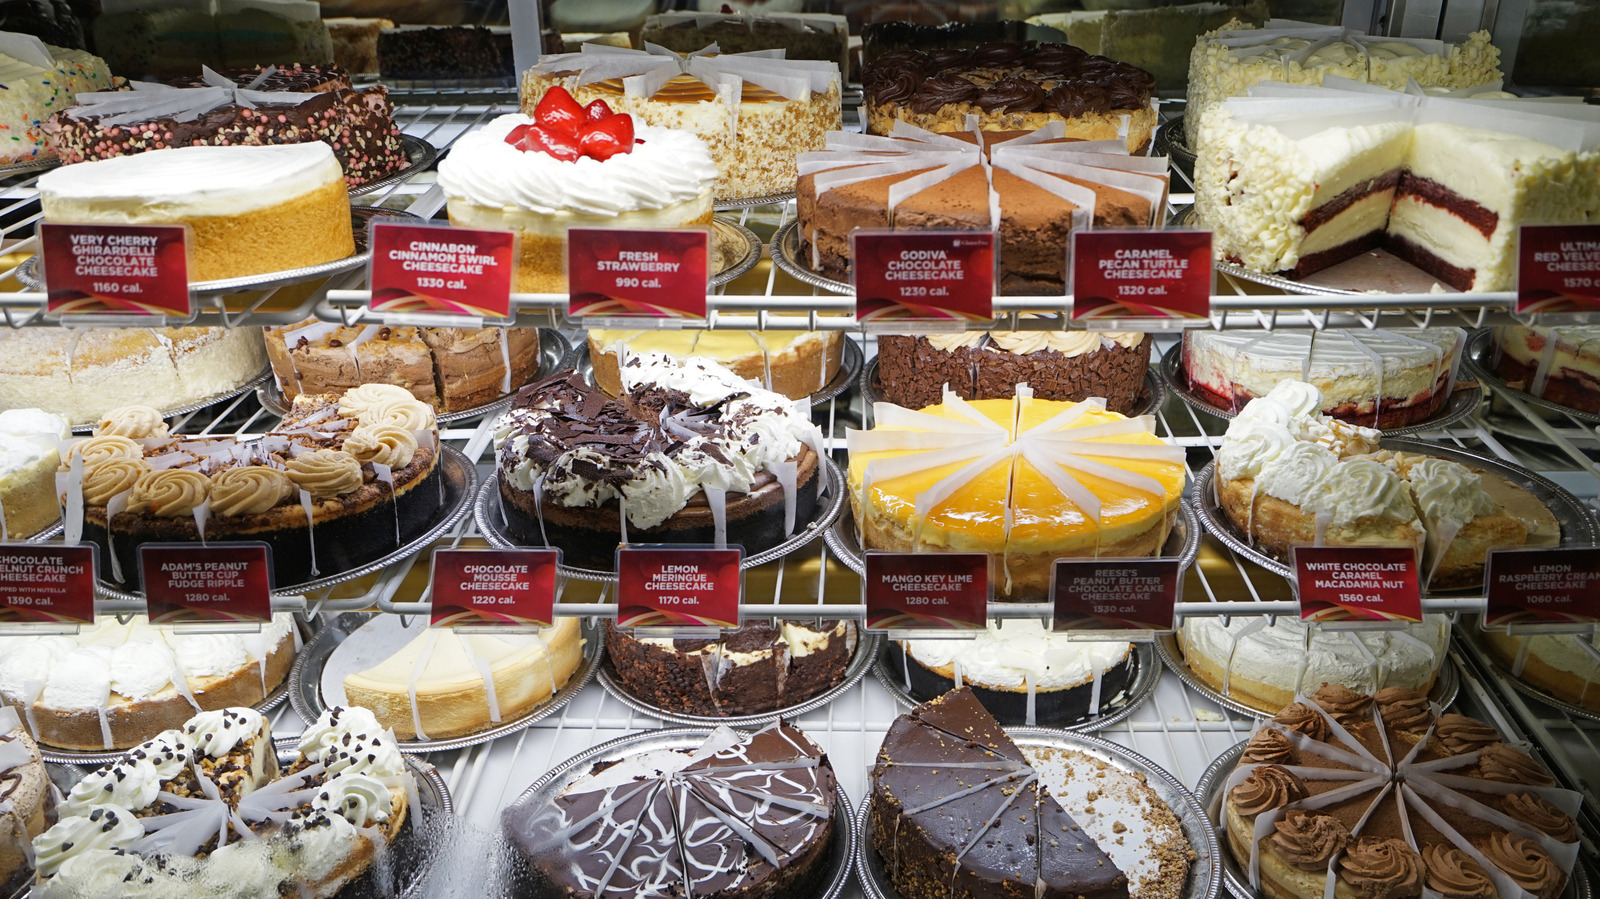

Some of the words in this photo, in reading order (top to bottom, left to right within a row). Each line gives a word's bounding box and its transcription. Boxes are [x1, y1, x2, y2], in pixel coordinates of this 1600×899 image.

[70, 235, 104, 244] VERY
[107, 236, 158, 246] CHERRY
[72, 246, 156, 256] GHIRARDELLI
[410, 241, 475, 254] CINNABON
[389, 250, 456, 262] CINNAMON
[458, 255, 498, 265] SWIRL
[619, 252, 658, 261] FRESH
[900, 251, 946, 260] GODIVA
[1115, 250, 1173, 259] CARAMEL
[1534, 253, 1560, 262] RED
[77, 256, 155, 267] CHOCOLATE
[888, 261, 961, 270] CHOCOLATE
[1099, 260, 1139, 269] PECAN
[1143, 259, 1188, 268] TURTLE
[403, 261, 483, 274] CHEESECAKE
[597, 261, 680, 272] STRAWBERRY
[76, 266, 158, 277] CHEESECAKE
[885, 271, 963, 280] CHEESECAKE
[1104, 270, 1182, 279] CHEESECAKE
[417, 277, 444, 288] 1330
[446, 280, 467, 289] cal.
[616, 278, 639, 287] 990
[641, 278, 661, 288] cal.
[1564, 278, 1591, 287] 1570
[93, 282, 119, 292] 1160
[122, 283, 143, 293] cal.
[900, 287, 926, 296] 1230
[929, 287, 949, 296] cal.
[1119, 286, 1145, 295] 1320
[1148, 285, 1167, 295] cal.
[37, 566, 83, 574] CRUNCH
[161, 563, 202, 571] ADAM'S
[661, 565, 698, 573] LEMON
[1306, 563, 1340, 571] WHITE
[1343, 563, 1406, 571] CHOCOLATE
[1533, 565, 1571, 573] LEMON
[172, 571, 214, 579] BUTTER
[217, 571, 238, 579] CUP
[1095, 569, 1138, 577] REESE'S
[1332, 572, 1382, 580] CARAMEL
[1499, 573, 1563, 582] RASPBERRY
[653, 574, 707, 582] MERINGUE
[882, 575, 922, 583] MANGO
[924, 575, 946, 583] KEY
[948, 575, 973, 583] LIME
[1119, 577, 1160, 585] BUTTER
[168, 580, 204, 588] FUDGE
[460, 582, 529, 590] CHEESECAKE
[645, 582, 714, 590] CHEESECAKE
[893, 583, 962, 591] CHEESECAKE
[1515, 581, 1586, 590] CHEESECAKE
[1069, 585, 1132, 593] CHOCOLATE
[7, 596, 32, 605] 1390
[35, 597, 53, 605] cal.
[212, 593, 230, 601] cal.
[472, 596, 495, 604] 1220
[498, 596, 515, 604] cal.
[659, 596, 680, 604] 1170
[682, 596, 699, 604] cal.
[1339, 594, 1363, 602] 1560
[1366, 594, 1383, 602] cal.
[1555, 595, 1572, 603] cal.
